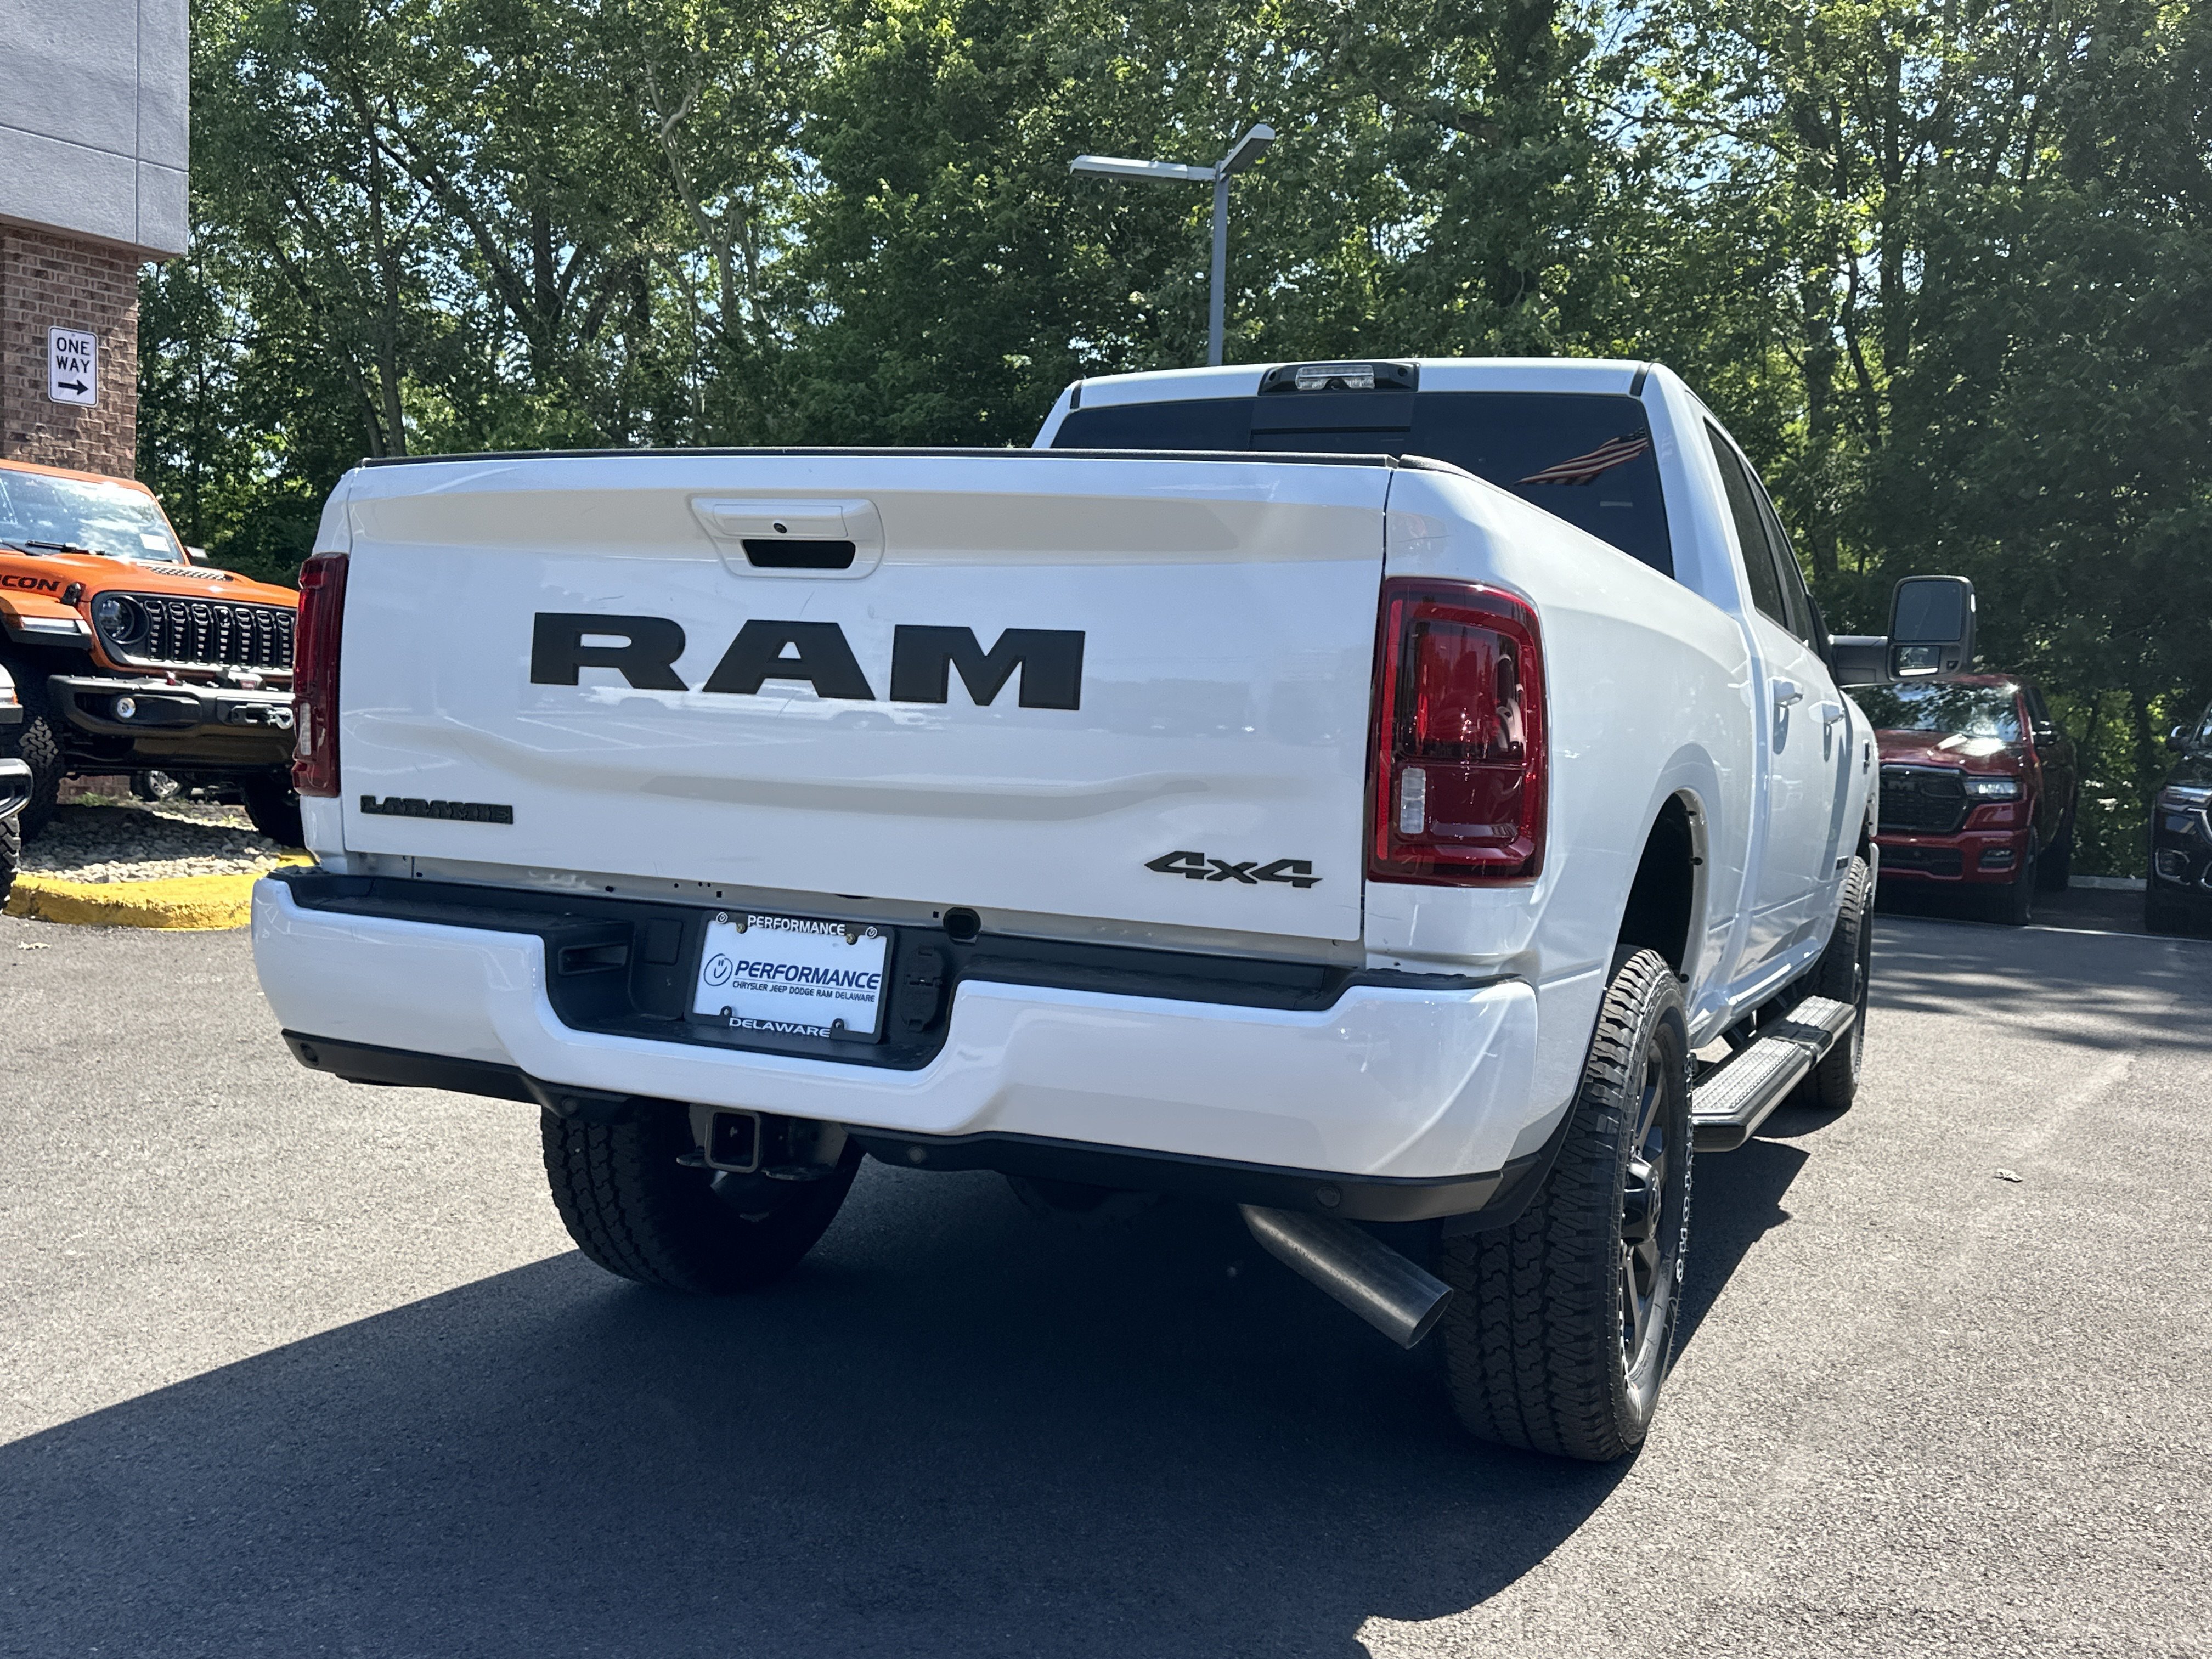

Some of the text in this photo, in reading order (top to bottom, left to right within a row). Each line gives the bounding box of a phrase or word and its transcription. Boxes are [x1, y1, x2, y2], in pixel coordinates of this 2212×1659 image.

[57, 337, 90, 356] ONE
[56, 355, 90, 373] WAY
[0, 574, 60, 591] CON
[530, 612, 1086, 710] RAM
[360, 795, 513, 825] LARAMIE
[747, 914, 846, 936] PERFORMANCE
[735, 960, 881, 990] PERFORMANCE
[732, 980, 876, 1002] CHRYSLER JEEP DODGE RAM DELAWARE
[729, 1018, 831, 1038] DELAWARE
